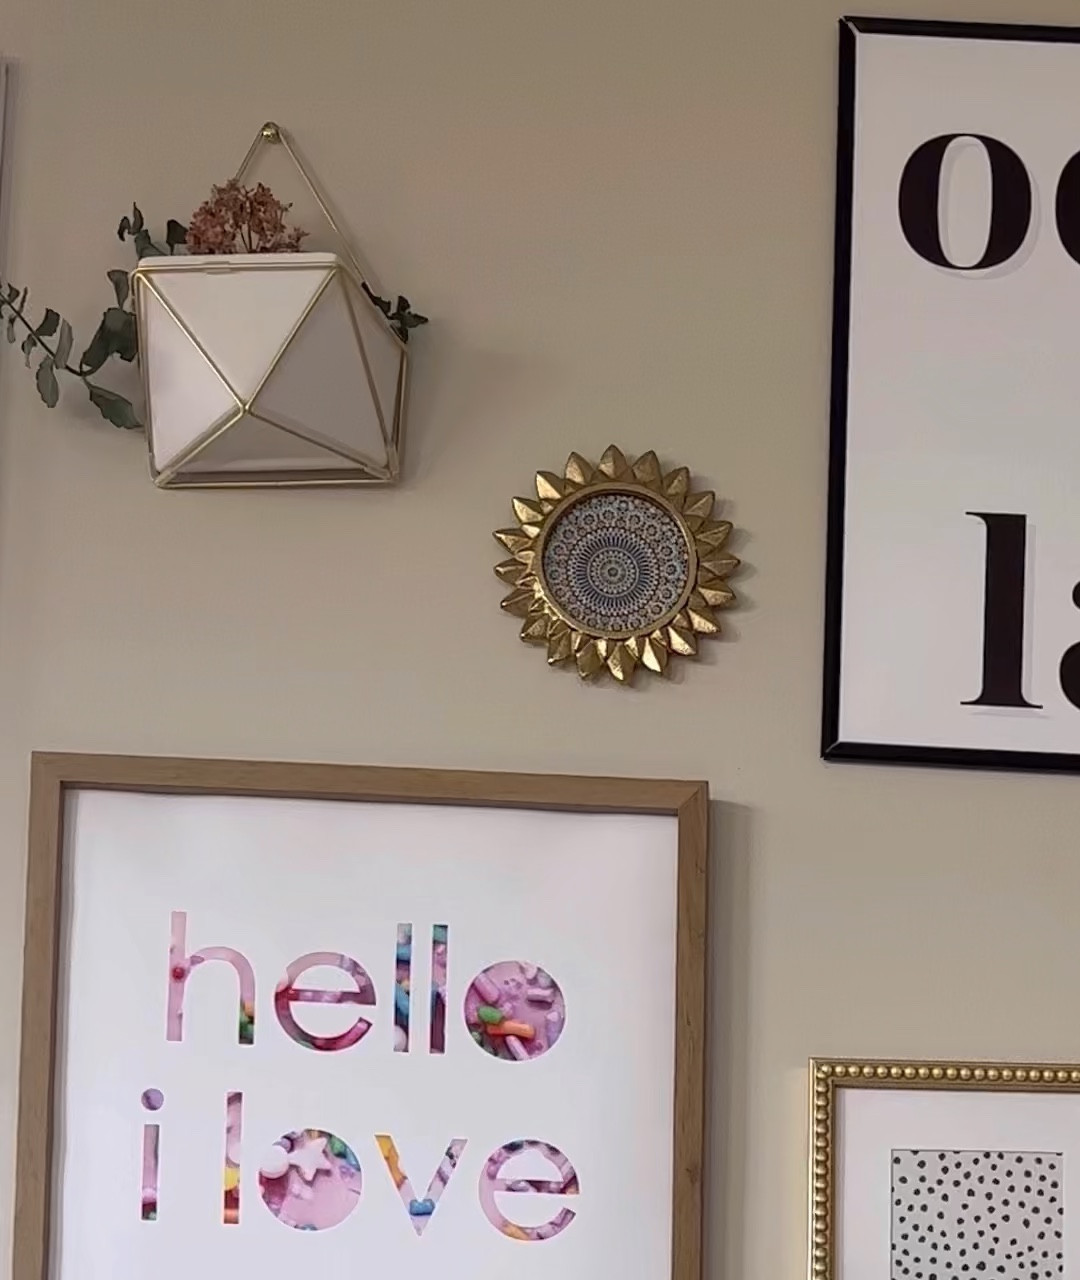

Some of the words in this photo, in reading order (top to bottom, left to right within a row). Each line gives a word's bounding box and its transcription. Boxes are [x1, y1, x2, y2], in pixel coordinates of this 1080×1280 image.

[166, 911, 566, 1063] hello
[140, 1087, 165, 1222] i
[223, 1090, 581, 1242] love
